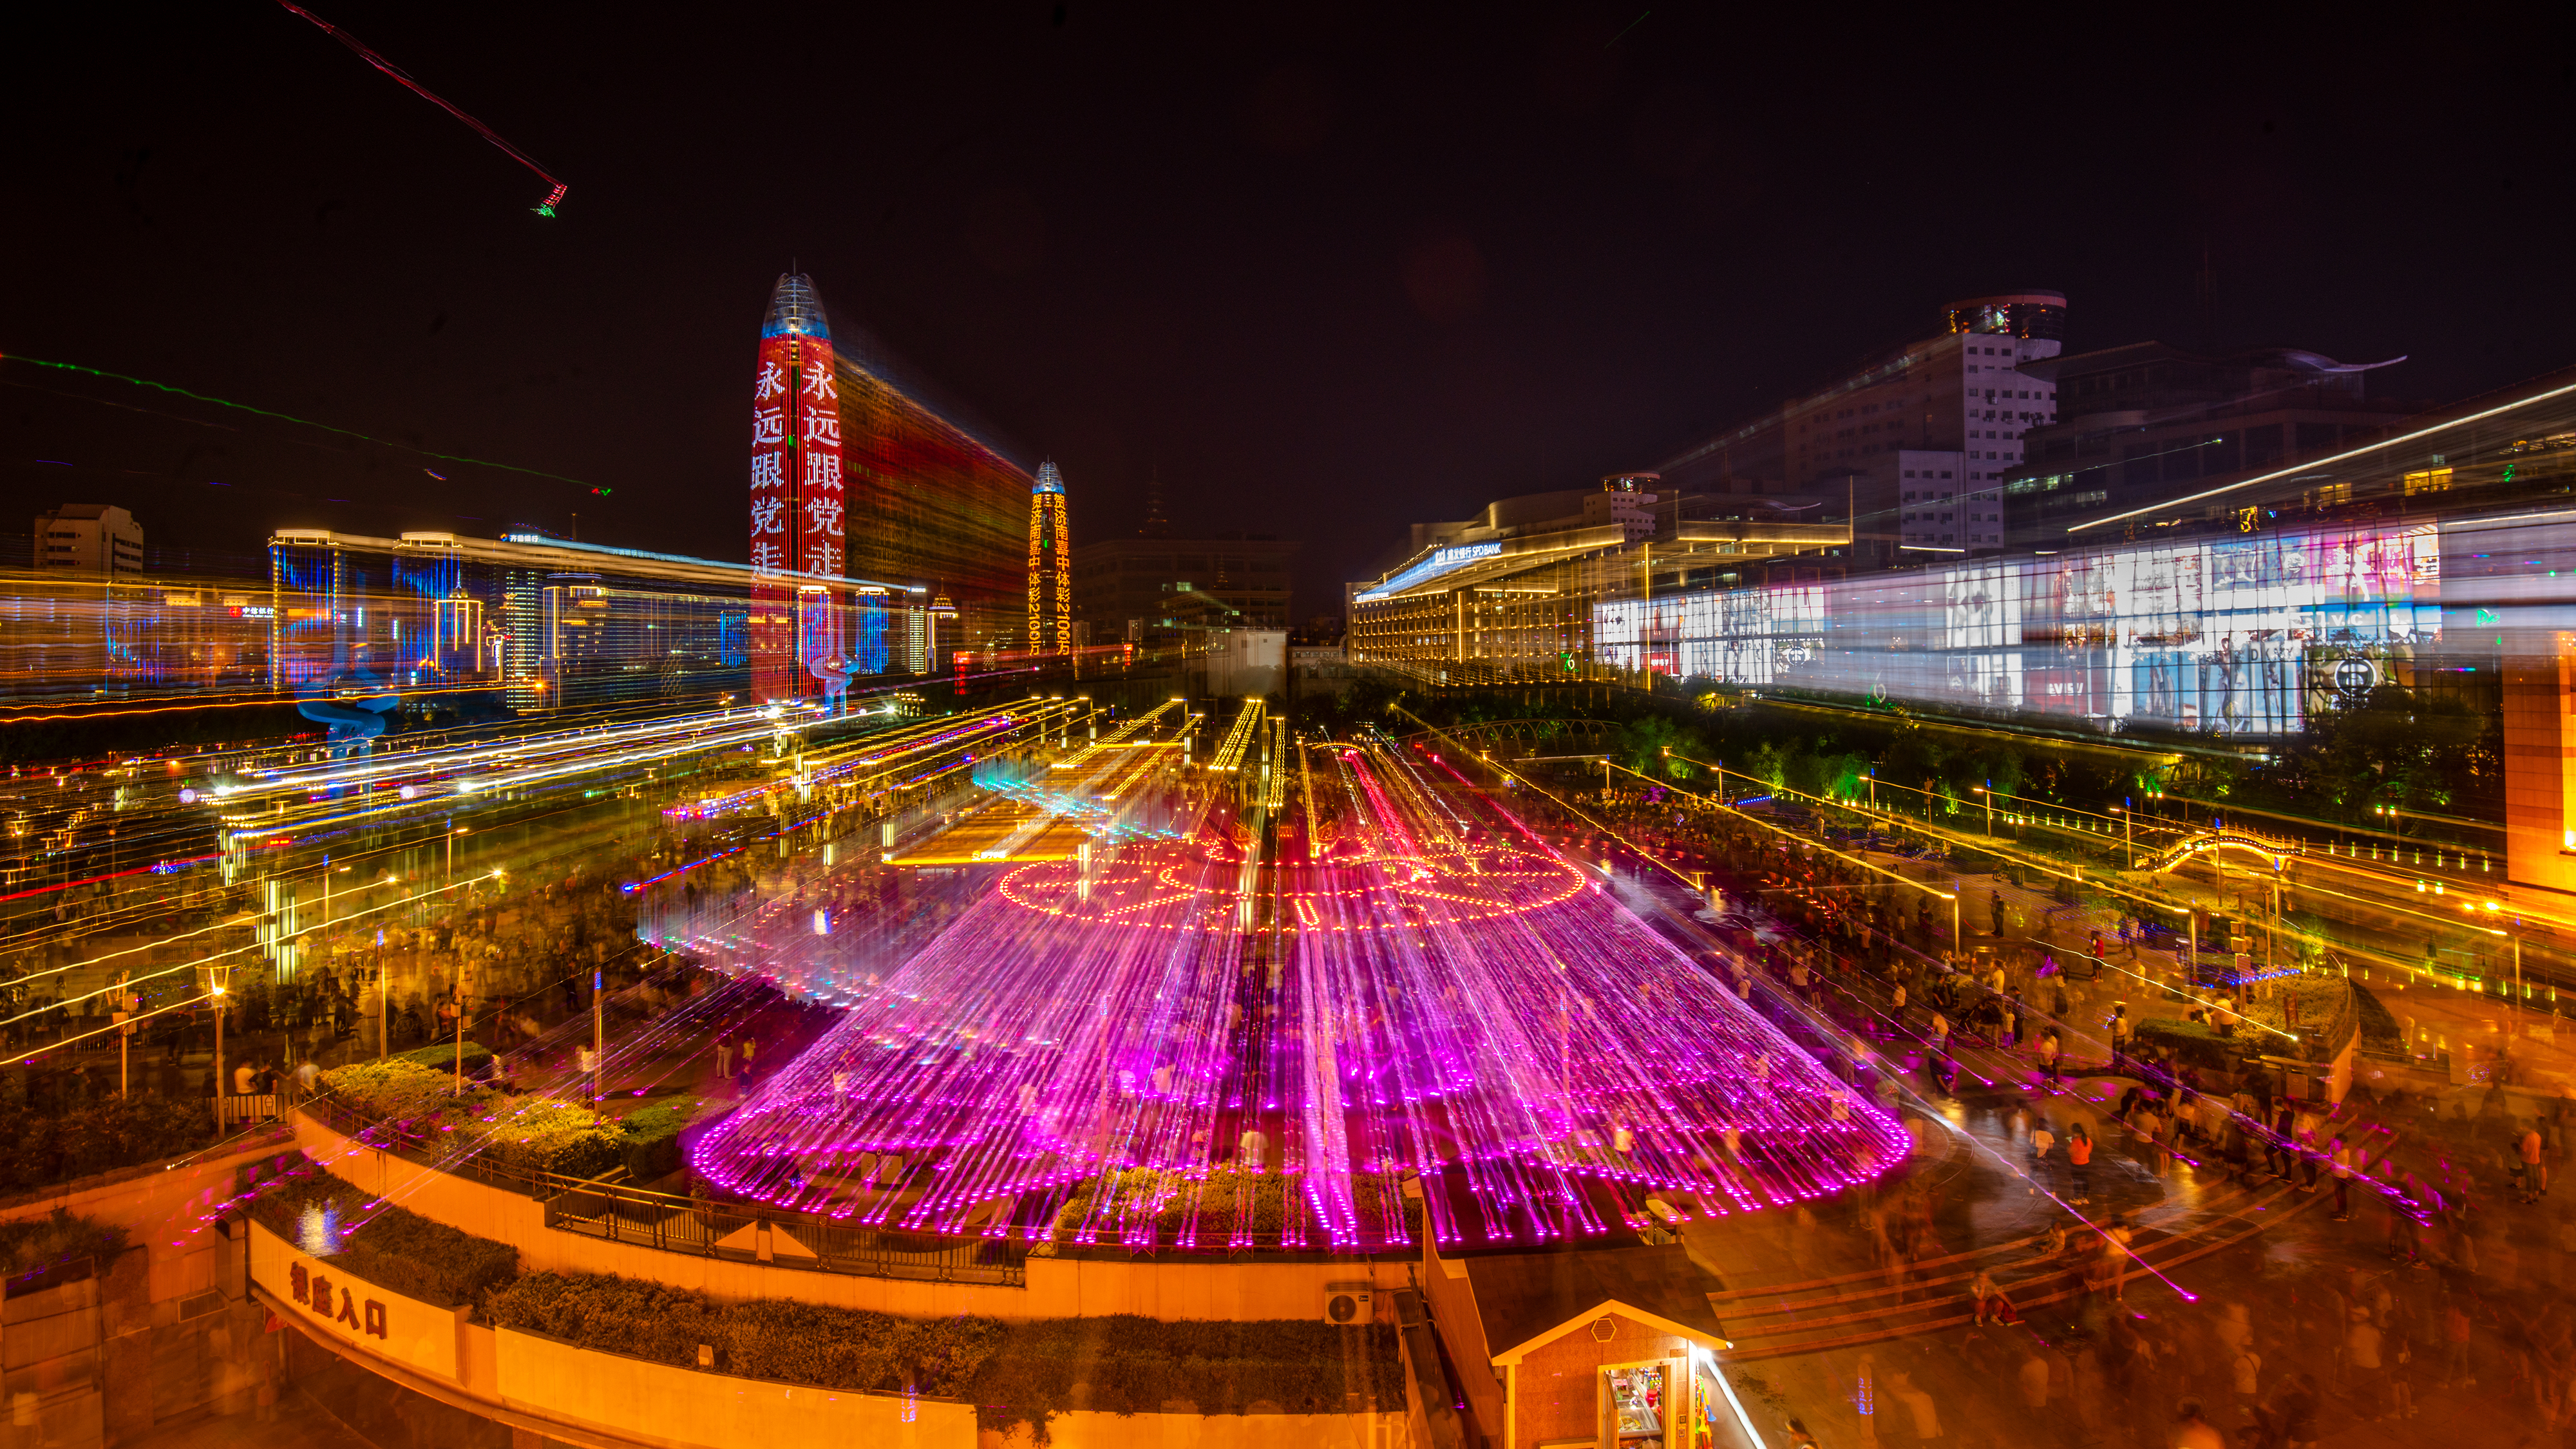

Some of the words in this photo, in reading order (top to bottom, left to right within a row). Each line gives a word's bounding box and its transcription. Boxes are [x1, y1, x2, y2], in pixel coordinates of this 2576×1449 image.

[1472, 545, 1484, 557] SPD
[1484, 543, 1501, 555] BANK
[1163, 753, 1182, 762] KFC
[290, 1261, 387, 1340] 银座入口
